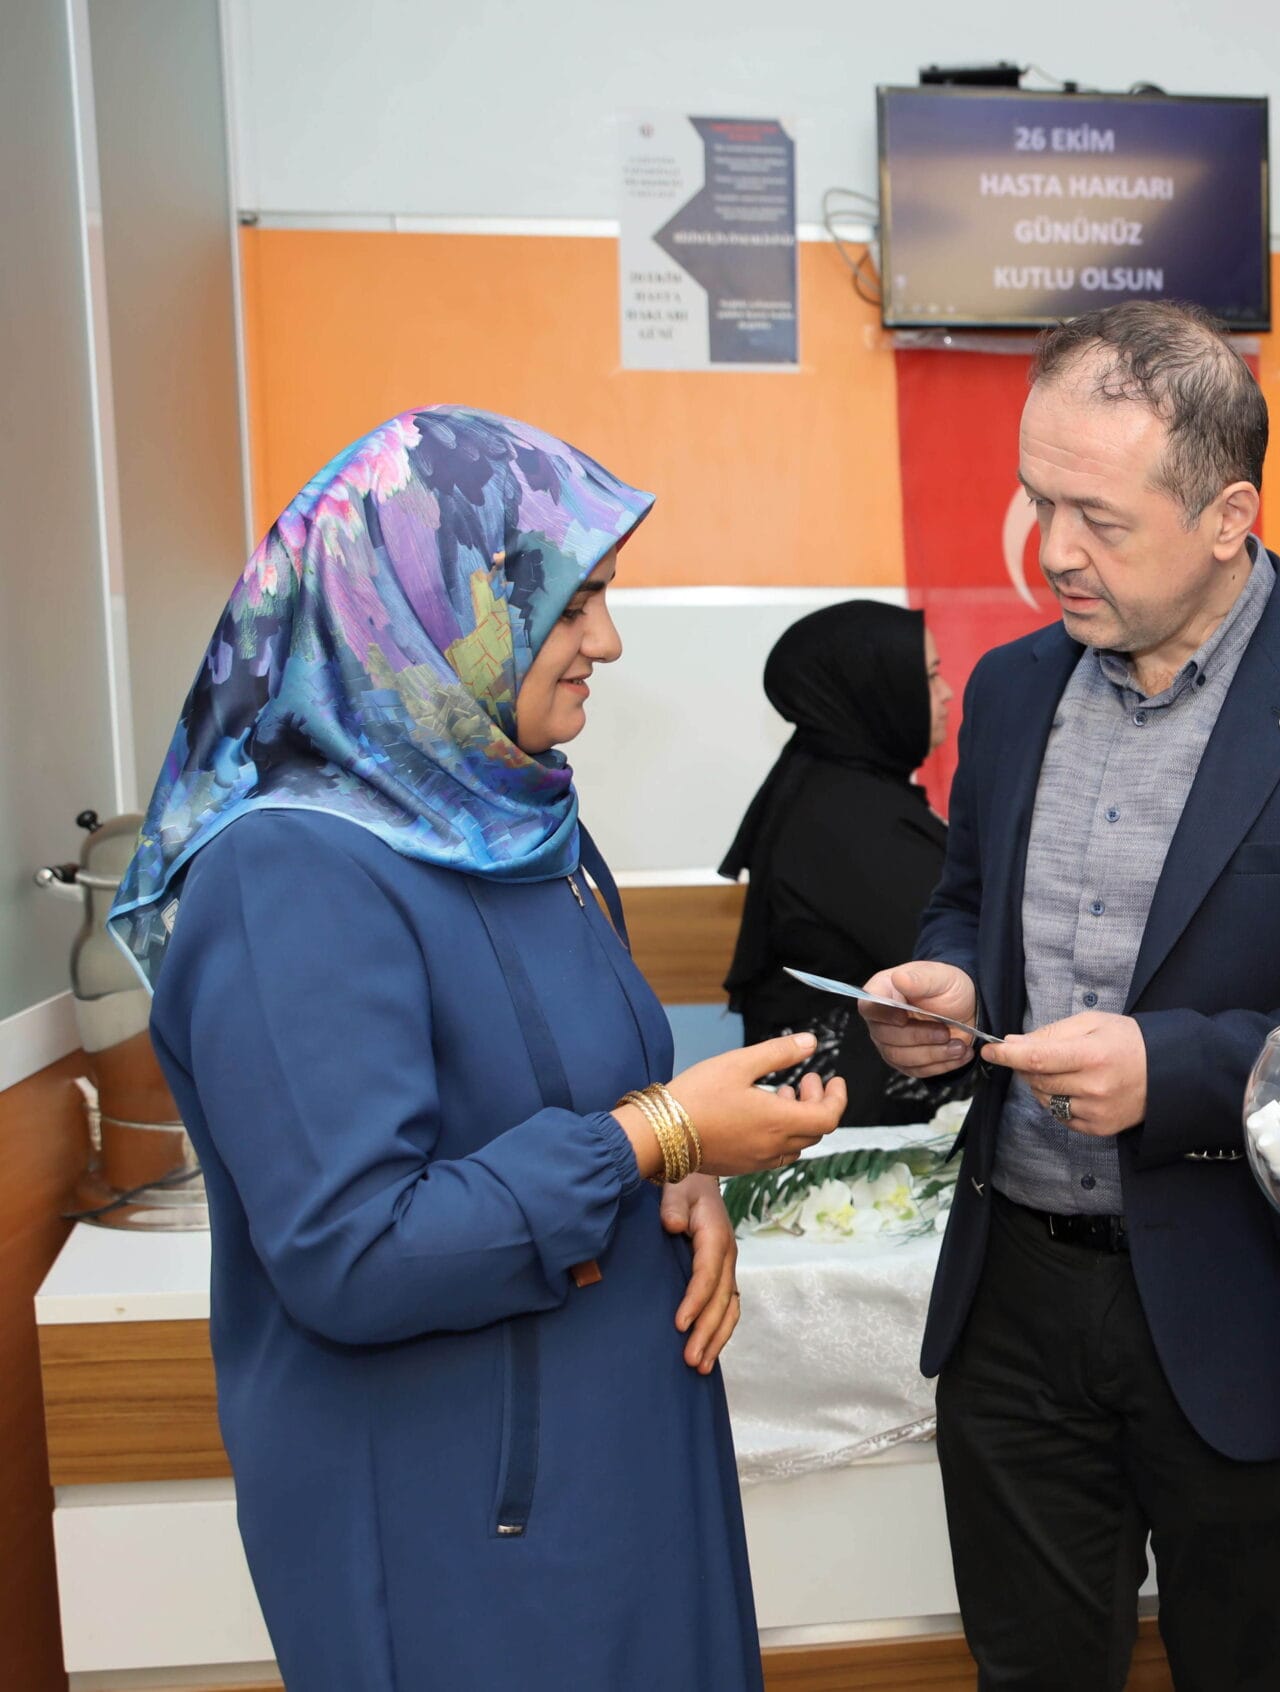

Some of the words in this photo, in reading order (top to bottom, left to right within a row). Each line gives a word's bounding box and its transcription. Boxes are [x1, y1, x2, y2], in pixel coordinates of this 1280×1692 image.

[1013, 126, 1046, 152] 26
[1051, 123, 1115, 153] EKİM
[980, 173, 1062, 198] HASTA
[1069, 174, 1174, 200] HAKLARI
[1014, 216, 1142, 246] GÜNÜNÜZ
[994, 266, 1075, 291] KUTLU
[1080, 267, 1164, 292] OLSUN
